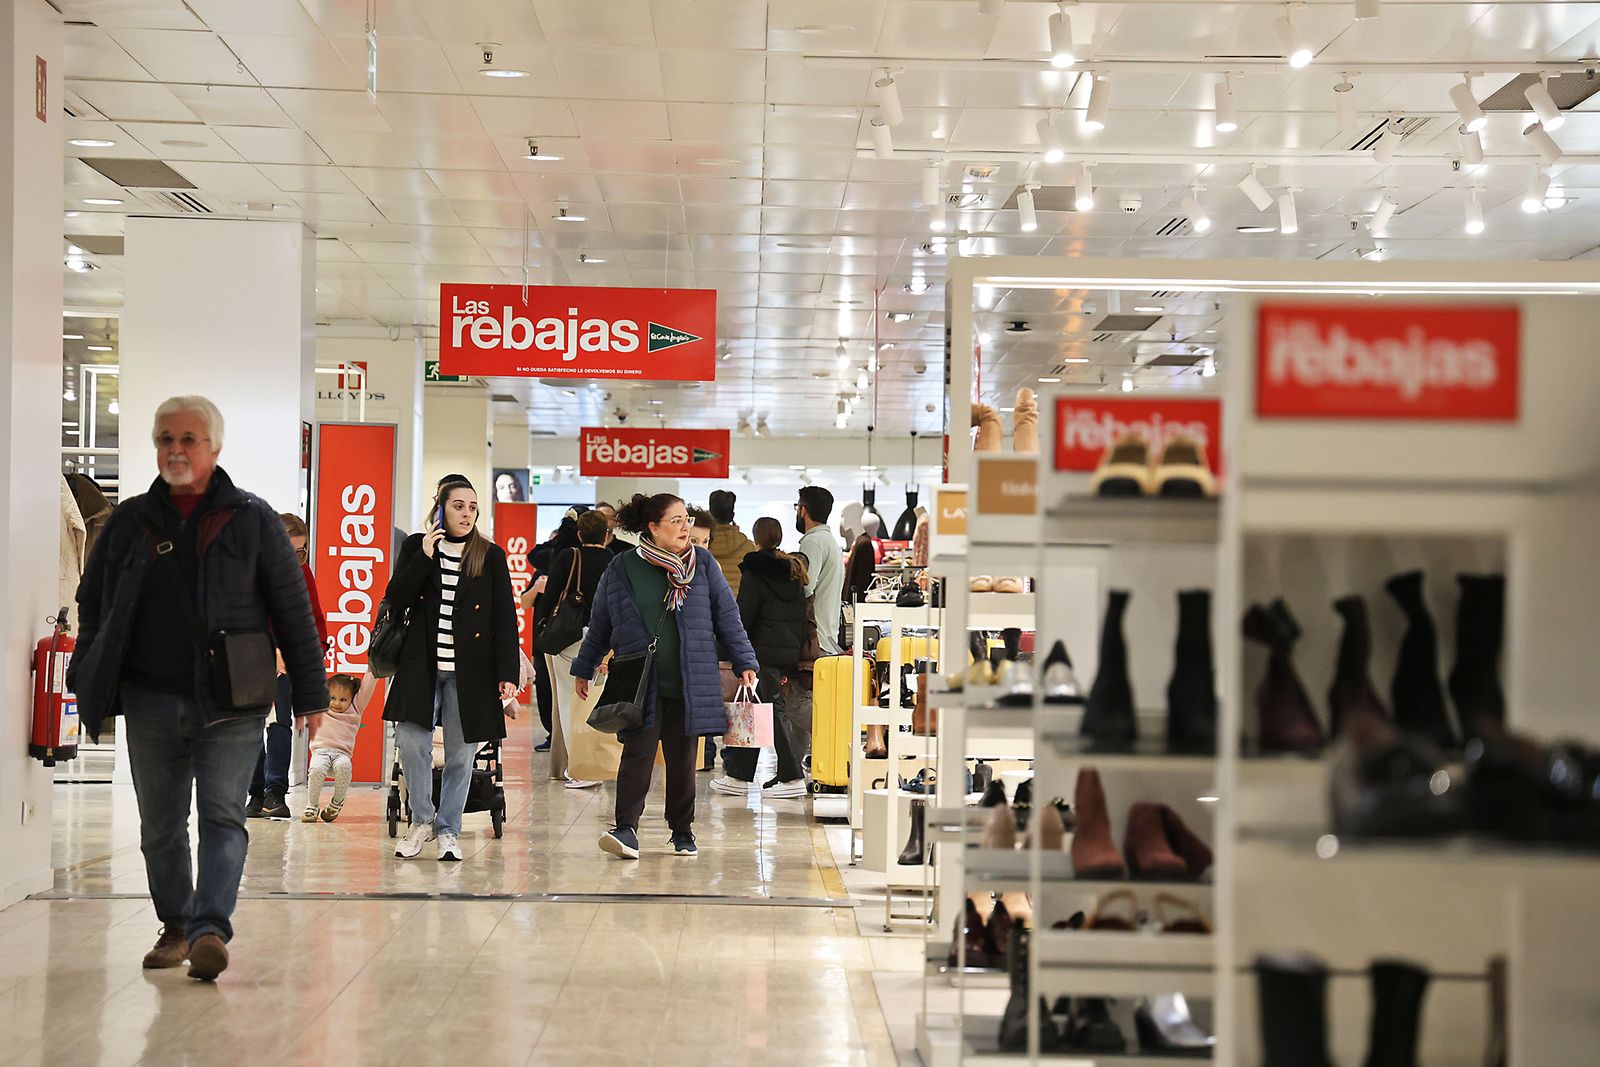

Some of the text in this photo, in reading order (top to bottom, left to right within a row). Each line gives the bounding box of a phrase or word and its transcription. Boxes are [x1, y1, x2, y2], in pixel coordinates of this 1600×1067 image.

[452, 295, 490, 315] Las
[452, 306, 641, 361] rebajas
[1268, 323, 1498, 402] rebajas
[586, 433, 607, 444] Las
[586, 438, 689, 469] rebajas
[943, 507, 969, 519] LA
[326, 484, 384, 674] rebajas
[325, 635, 336, 673] Las
